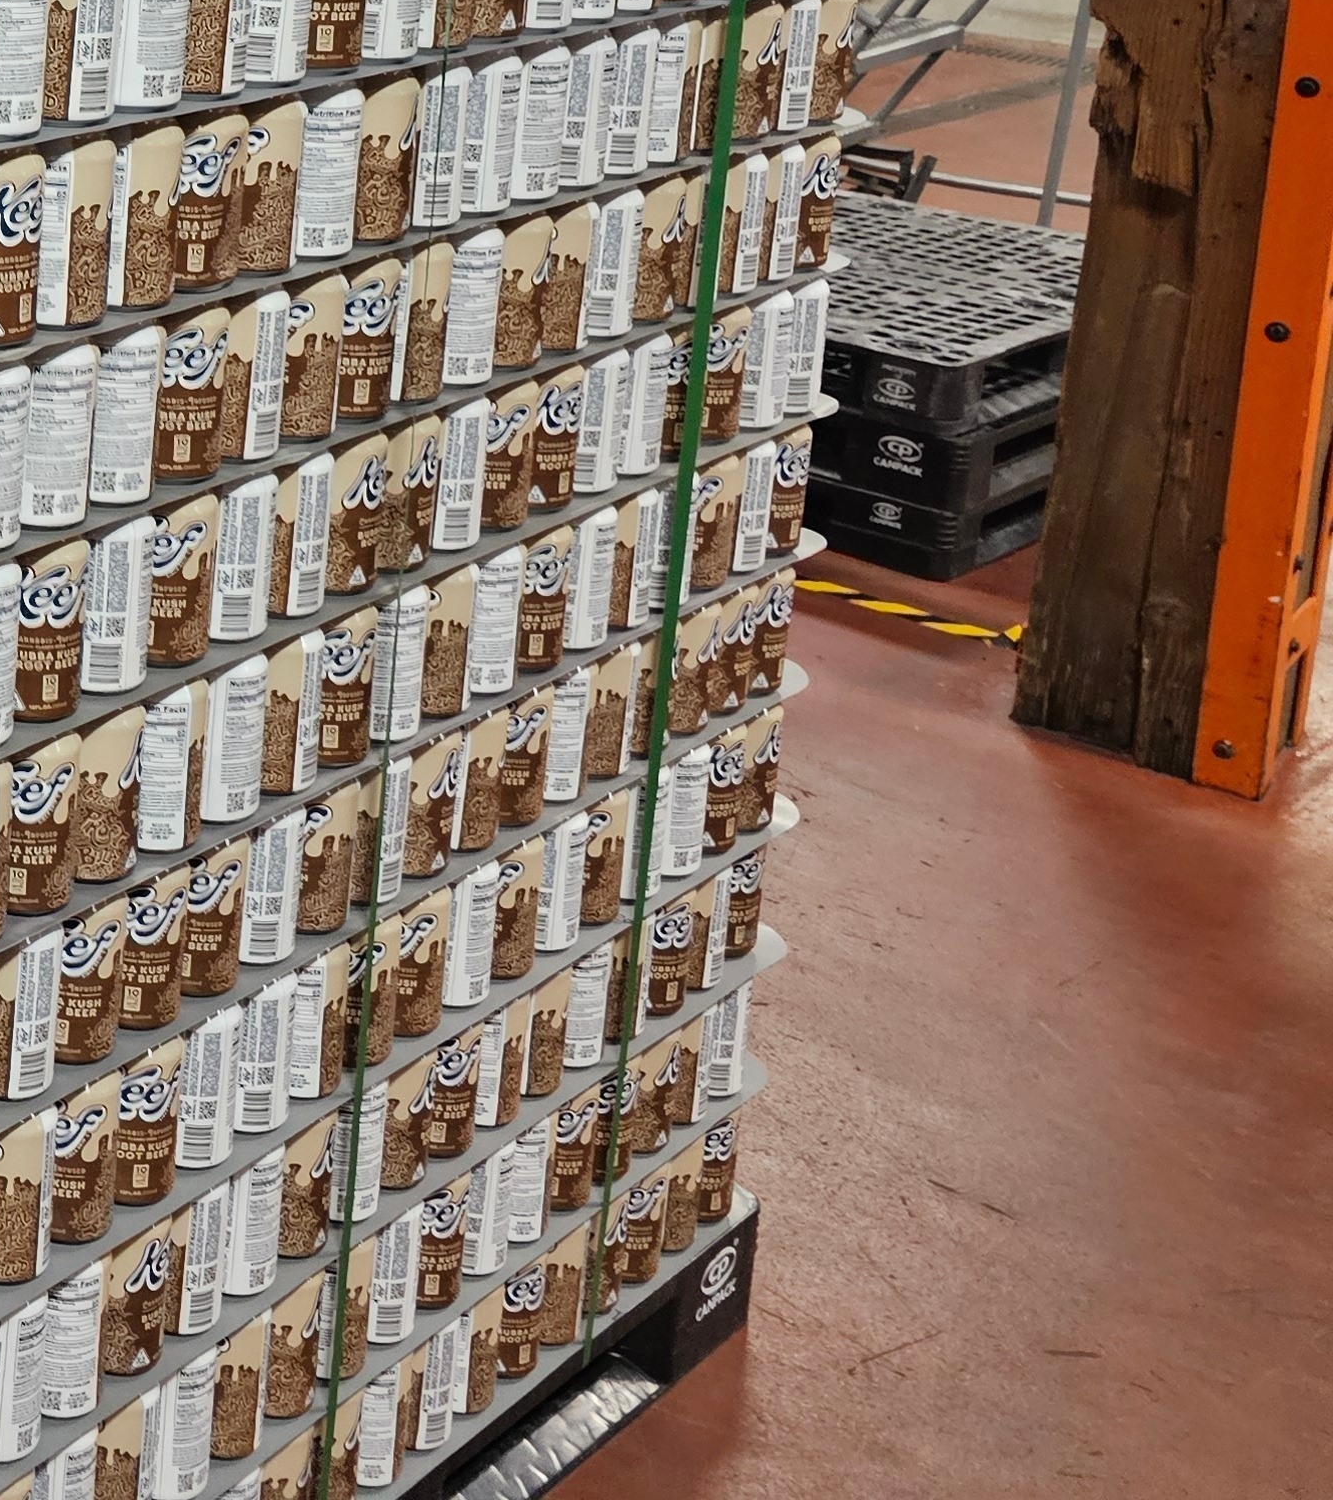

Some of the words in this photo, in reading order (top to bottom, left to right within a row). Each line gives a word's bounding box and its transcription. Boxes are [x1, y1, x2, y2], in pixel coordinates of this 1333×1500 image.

[333, 1, 361, 12] KUSH
[326, 10, 358, 22] BEER
[873, 456, 923, 477] CANPACK
[190, 933, 222, 943] KUSH
[188, 942, 218, 951] BEER
[140, 964, 170, 974] KUSH
[138, 974, 166, 983] BEER
[127, 988, 140, 996] 10
[68, 999, 102, 1008] KUSH
[66, 1008, 97, 1017] BEER
[146, 1147, 169, 1160] BEER
[53, 1179, 85, 1190] KUSH
[52, 1188, 81, 1199] BEER
